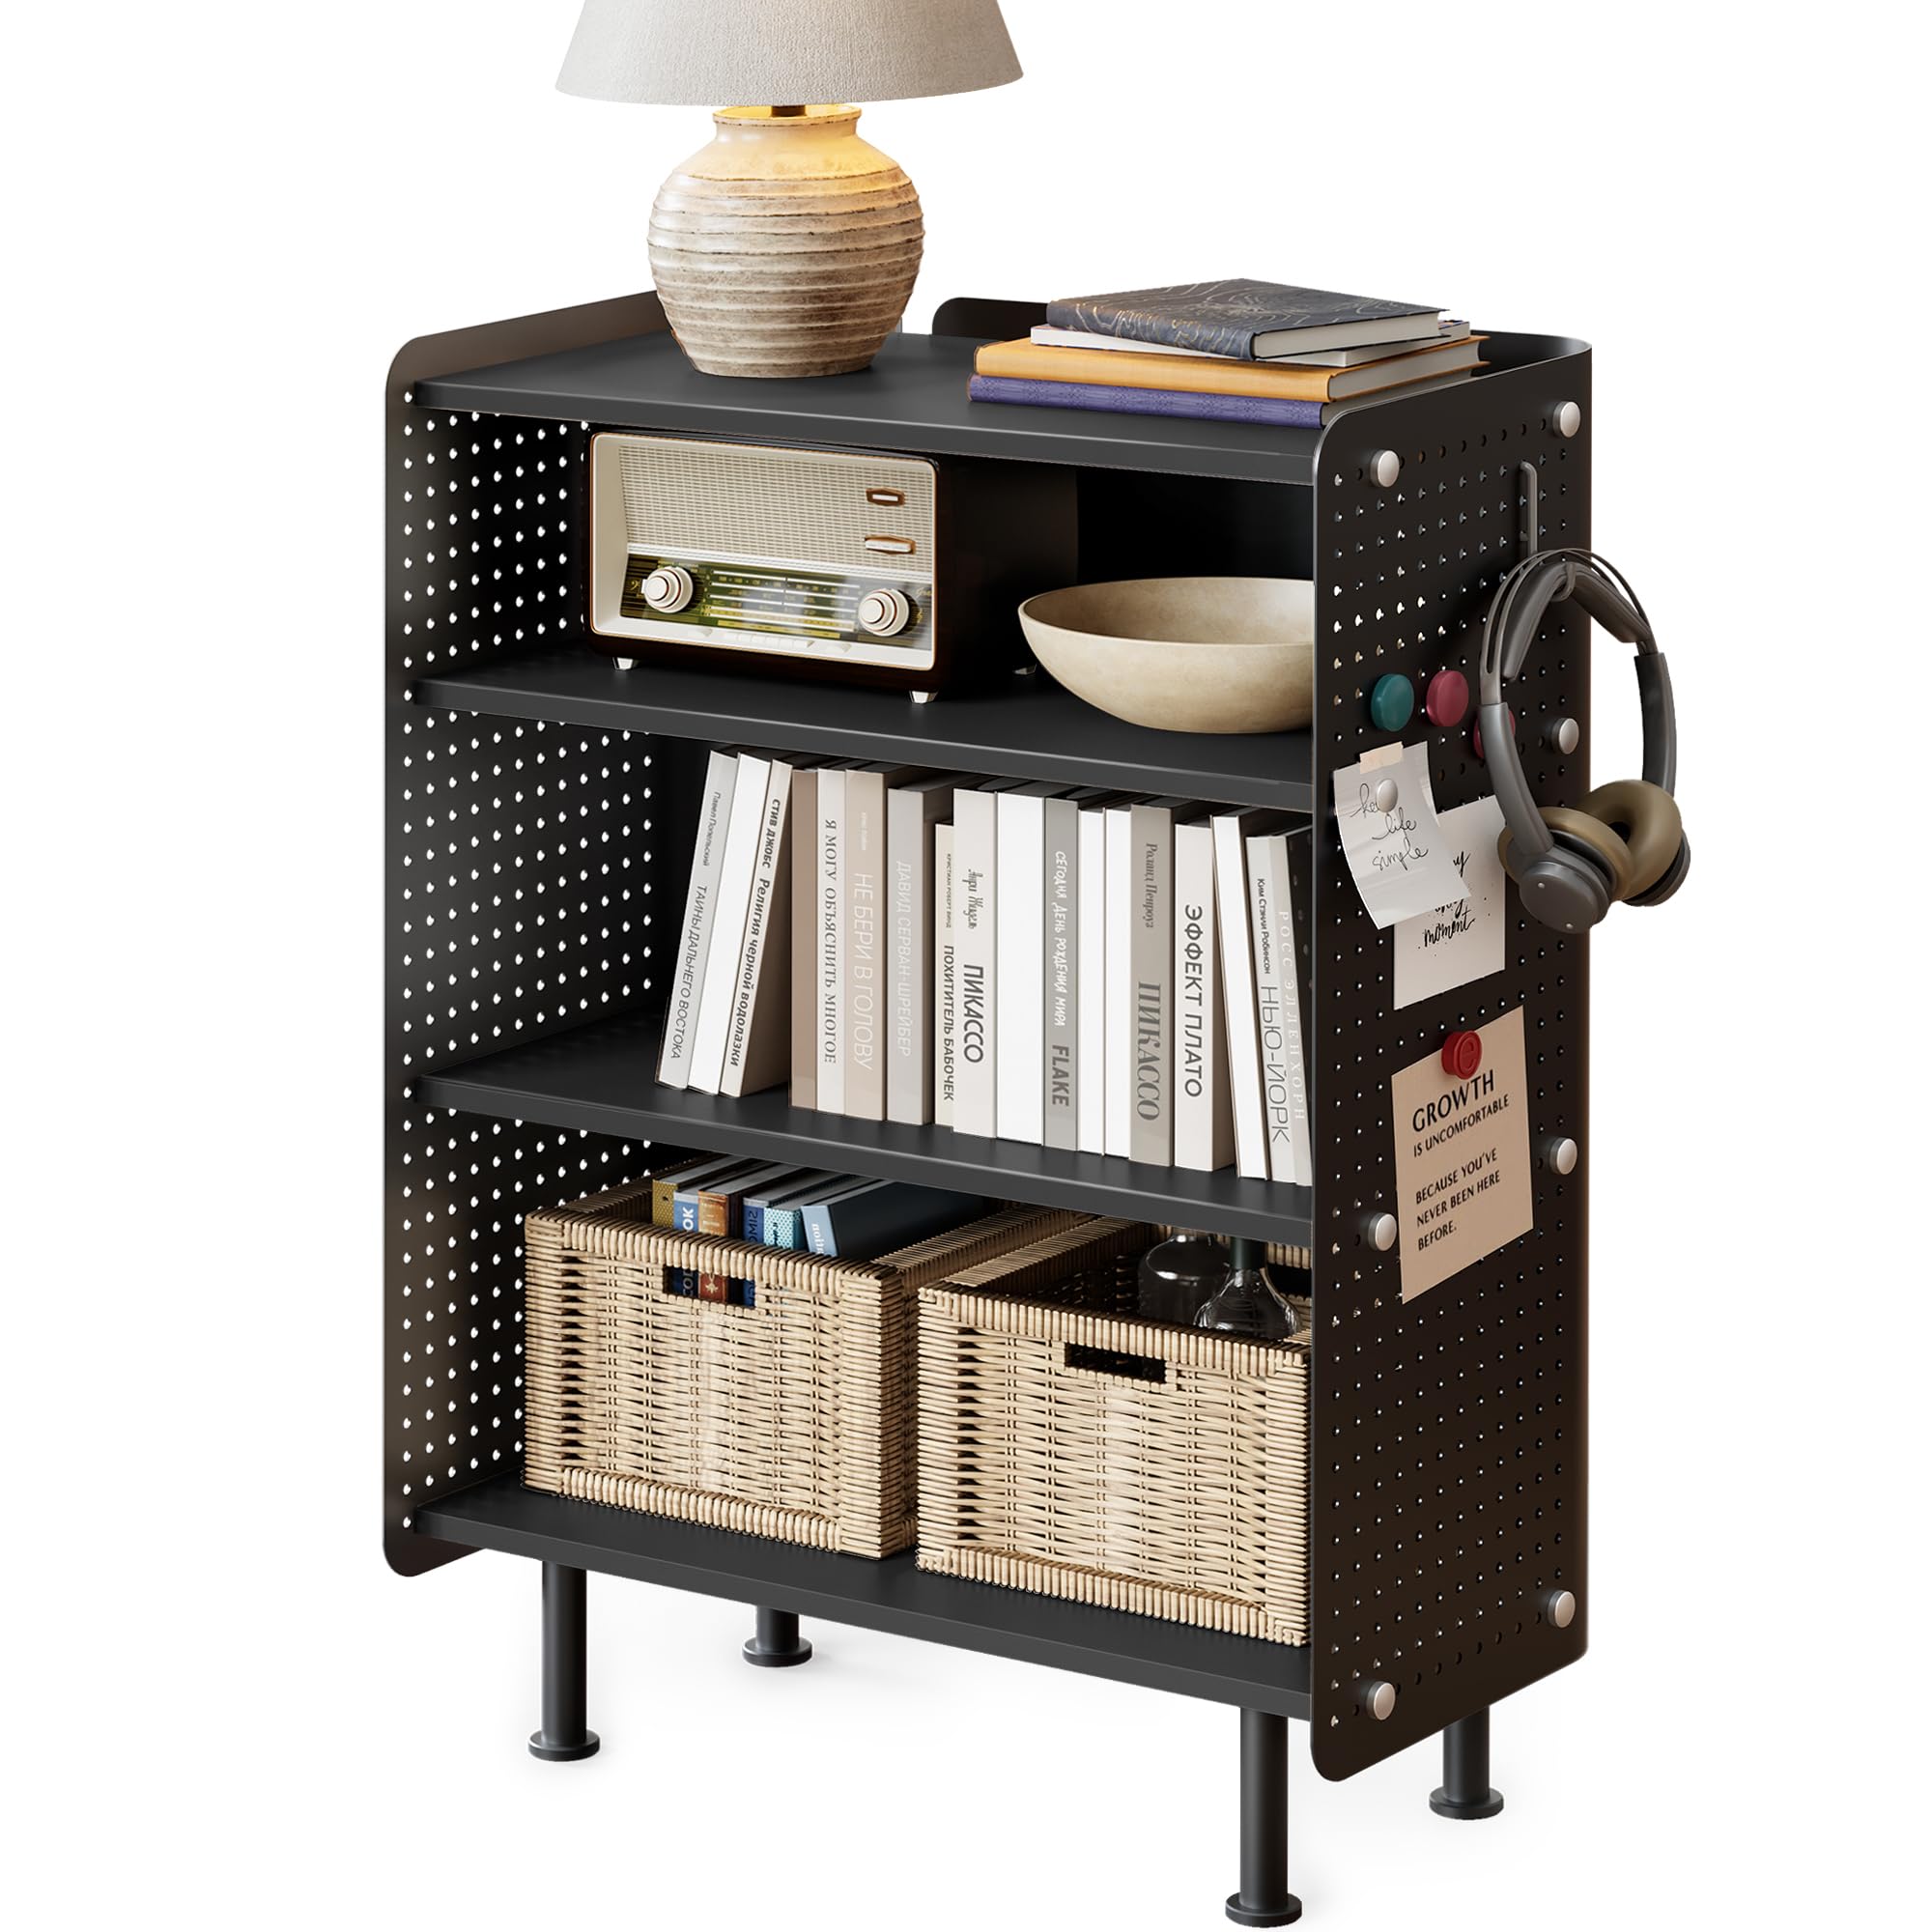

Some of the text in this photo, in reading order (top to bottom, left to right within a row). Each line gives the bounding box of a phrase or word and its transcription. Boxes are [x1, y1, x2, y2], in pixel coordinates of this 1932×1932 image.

[1372, 807, 1417, 839] life
[1372, 836, 1429, 871] simple
[751, 877, 771, 936] Религия
[854, 872, 874, 900] НЕ
[1142, 842, 1158, 928] Роланд Пенроуз
[824, 819, 838, 1064] Я МОГУ ОБЪЯСНИТЬ МНОГОЕ
[854, 905, 873, 960] БЕРИ
[895, 860, 912, 1057] ДАВИД СЕРВАН-ШРЕЙБЕР
[1051, 851, 1068, 1026] СЕГОДНЯ ДЕНЬ РОЖДЕНИЯ МИРА
[1423, 906, 1476, 948] moment
[680, 928, 700, 999] ДАЛЬНЕГО
[742, 938, 758, 989] черной
[854, 965, 873, 980] В
[670, 999, 690, 1059] ВОСТОКА
[729, 991, 750, 1066] водолазки
[853, 984, 873, 1070] ГОЛОВУ
[944, 945, 954, 1101] ПОХИТИТЕЛЬ БАБОЧЕК
[963, 964, 983, 1064] ПИКАССО
[1184, 904, 1203, 1097] ЭФФЕКТ ПЛАТО
[1278, 911, 1305, 1120] РОСС ЭЛЛЕНХОРН
[1052, 1044, 1069, 1106] FLAKE
[1137, 980, 1161, 1121] ПИКАССО
[1260, 985, 1291, 1143] НЬЮ-ЙОРК
[1411, 1068, 1495, 1132] GROWTH
[1413, 1093, 1510, 1158] IS UNCOMFORTABLE
[1415, 1169, 1459, 1205] BECAUSE
[1416, 1170, 1500, 1228] NEVER BEEN HERE
[1418, 1219, 1457, 1251] BEFORE.
